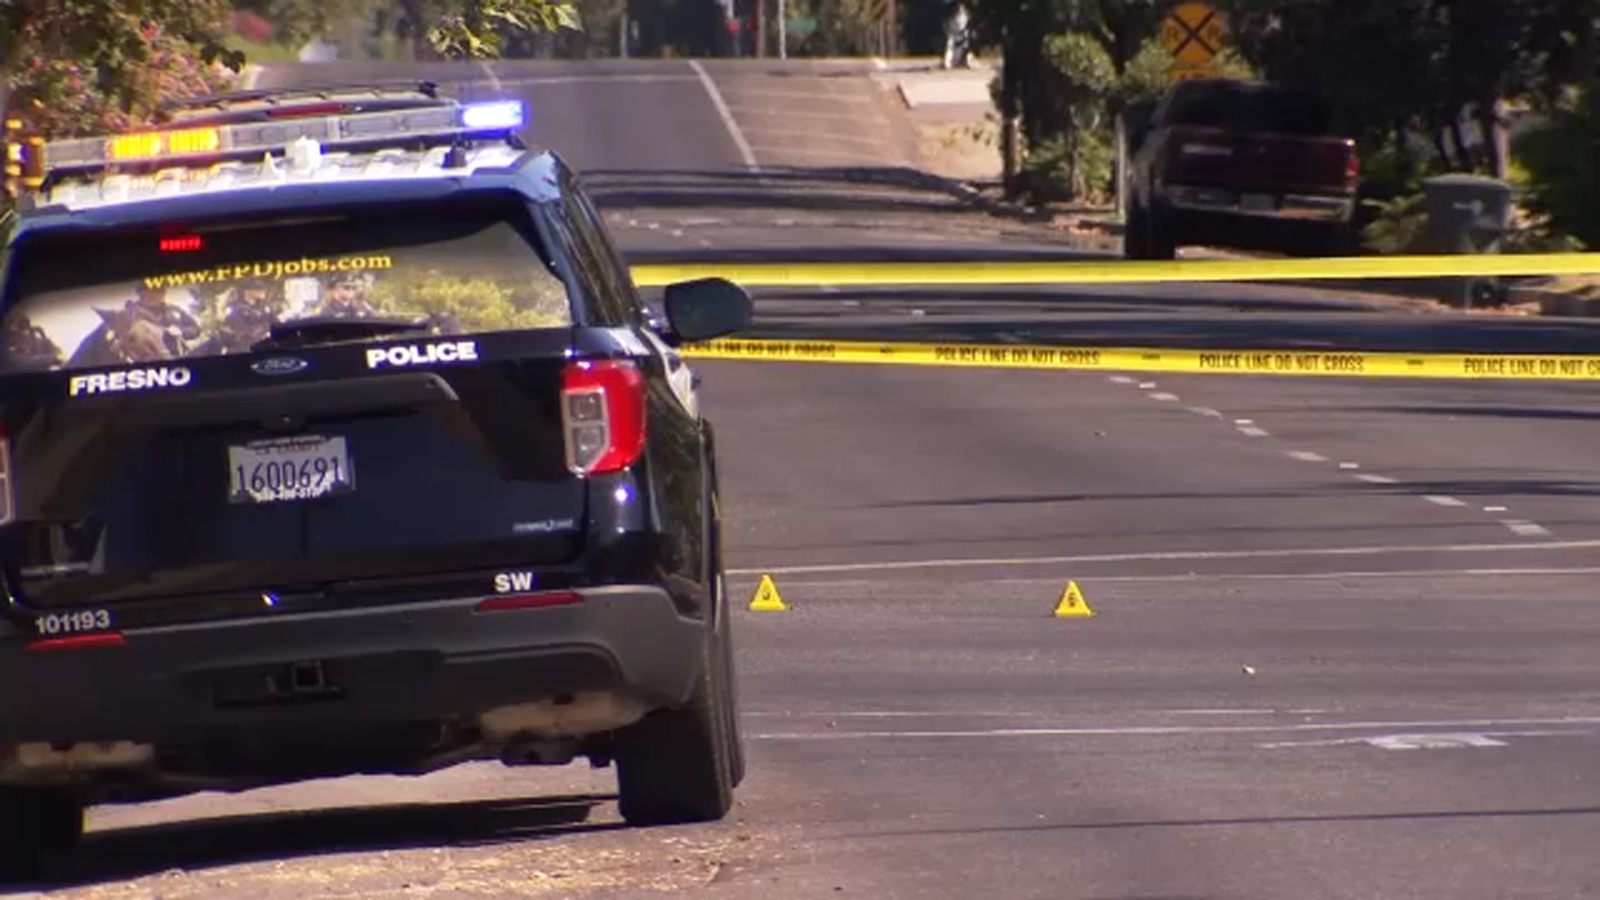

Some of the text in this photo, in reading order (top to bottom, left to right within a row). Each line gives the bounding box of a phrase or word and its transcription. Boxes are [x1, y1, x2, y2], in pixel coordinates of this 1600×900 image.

[365, 341, 479, 369] POLICE
[934, 346, 1100, 366] POLICE LINE DO NOT CROSS
[1199, 353, 1365, 372] POLICE LINE DO NOT CROSS
[1463, 357, 1506, 374] POLICE
[1508, 358, 1538, 375] LINE
[1539, 359, 1557, 375] DO
[1559, 359, 1584, 376] NOT
[69, 366, 192, 396] FRESNO
[237, 456, 340, 496] 1600691
[494, 571, 533, 593] SW
[34, 608, 111, 634] 101193
